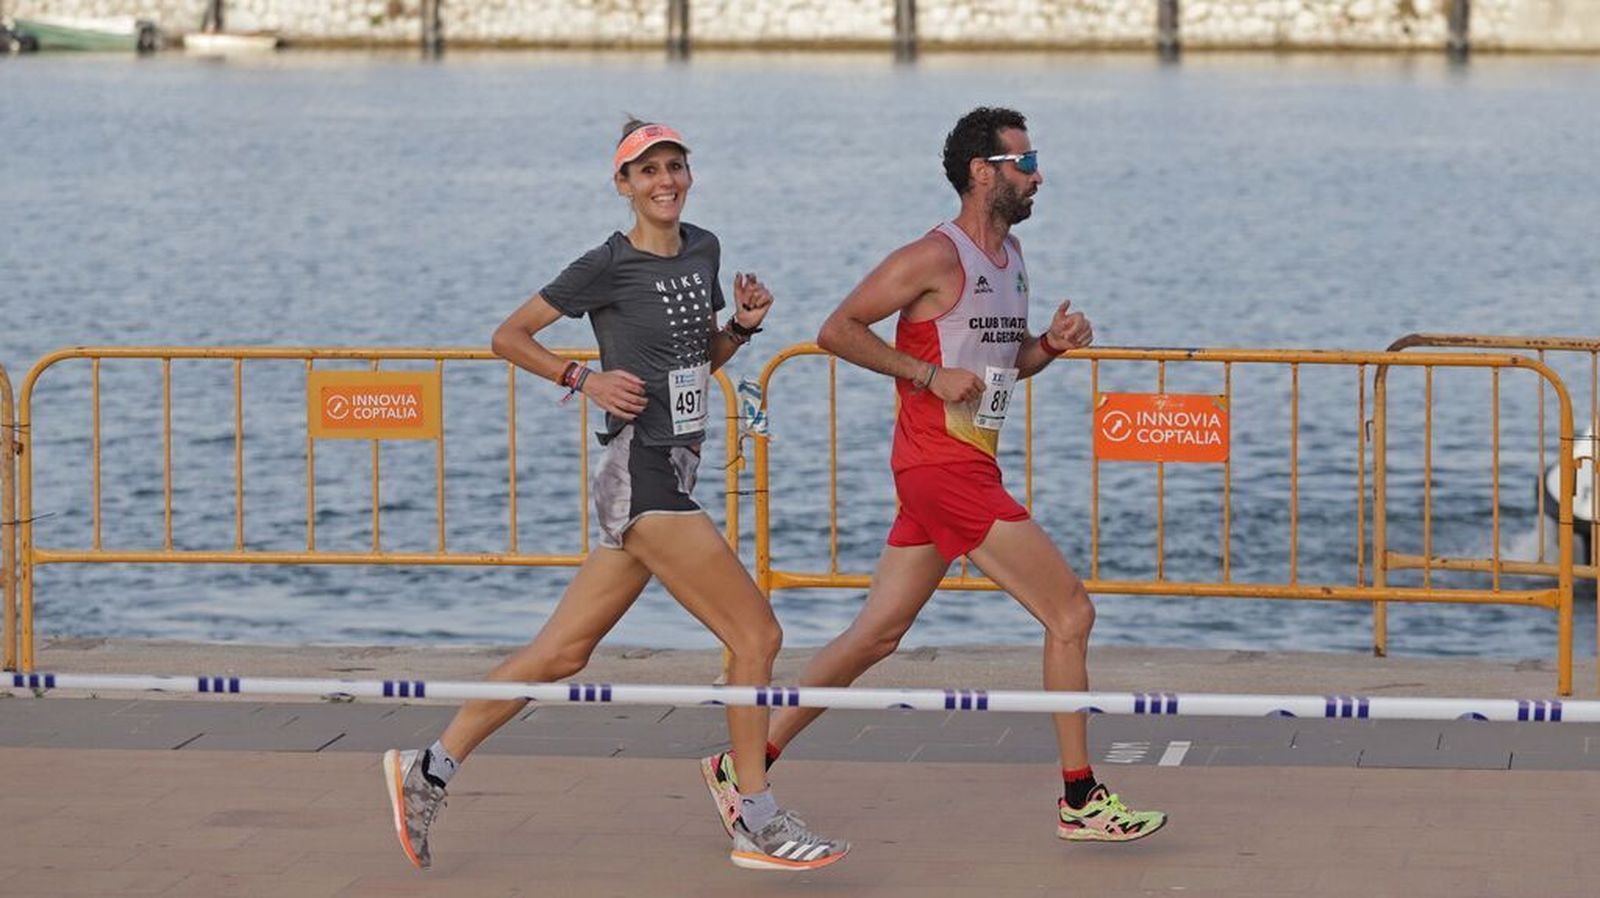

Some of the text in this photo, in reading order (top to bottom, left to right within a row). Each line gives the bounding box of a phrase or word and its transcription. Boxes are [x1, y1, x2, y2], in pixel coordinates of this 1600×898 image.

[655, 272, 703, 292] NIKE
[969, 316, 999, 329] CLUB
[352, 394, 417, 406] INNOVIA
[675, 389, 702, 415] 497
[353, 407, 417, 419] COPTALIA
[1136, 411, 1221, 427] INNOVIA
[1136, 428, 1221, 445] COPTALIA
